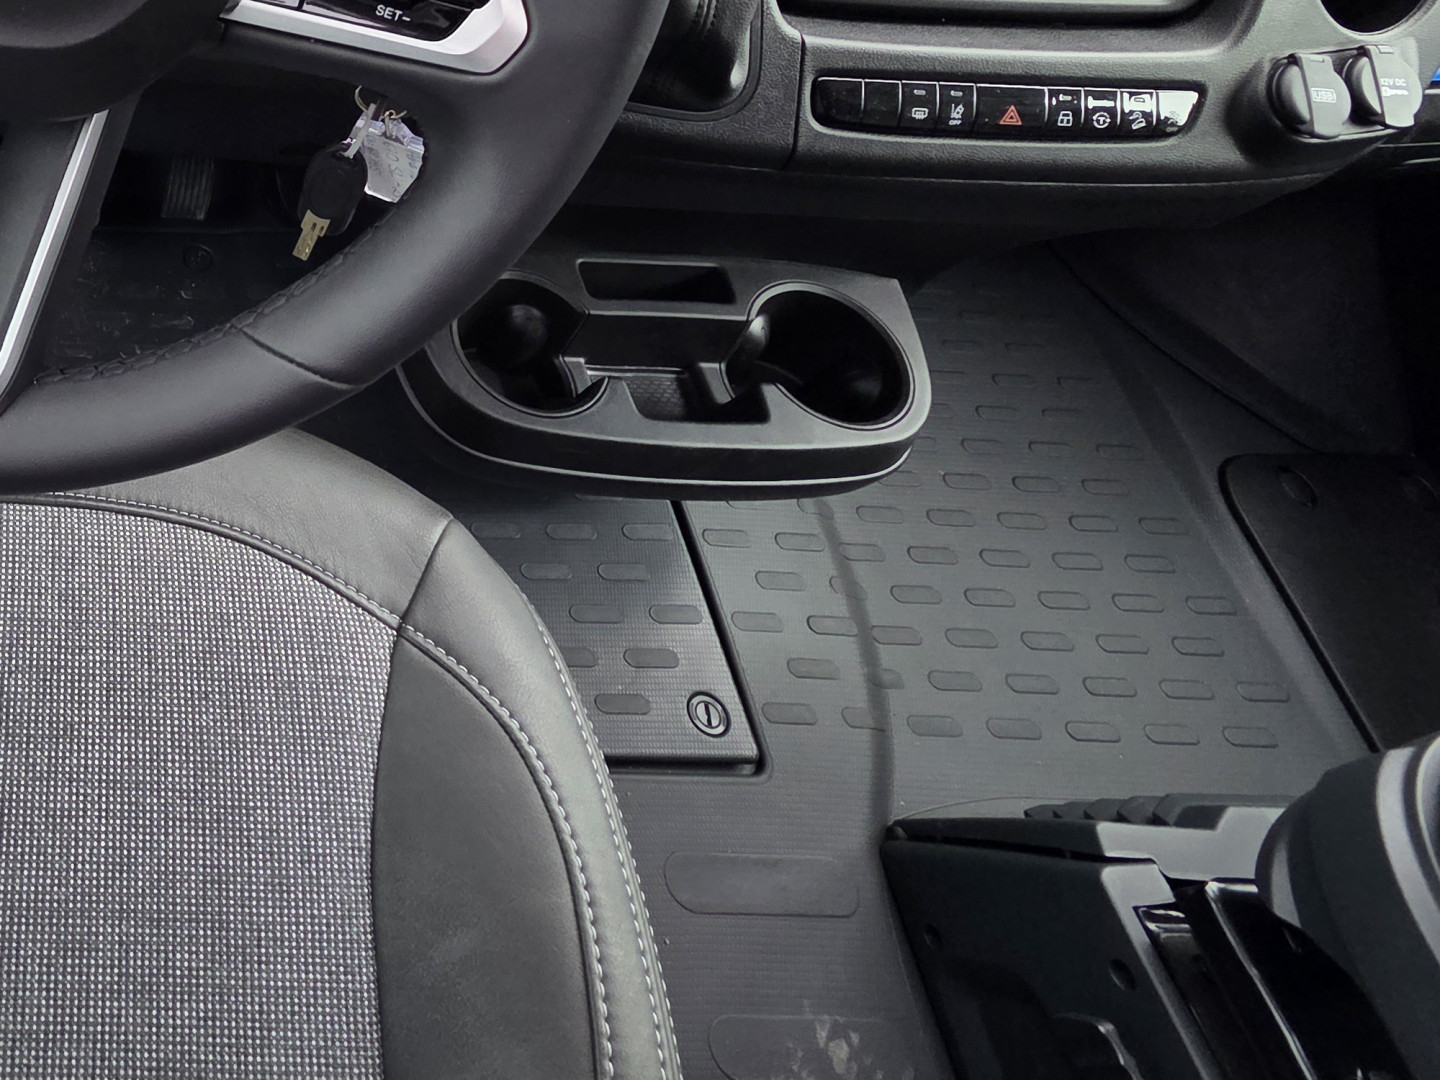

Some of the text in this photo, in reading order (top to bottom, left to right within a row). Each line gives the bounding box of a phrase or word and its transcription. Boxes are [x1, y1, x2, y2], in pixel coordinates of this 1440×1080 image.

[1380, 78, 1407, 87] 12V DC
[1312, 90, 1335, 101] USB
